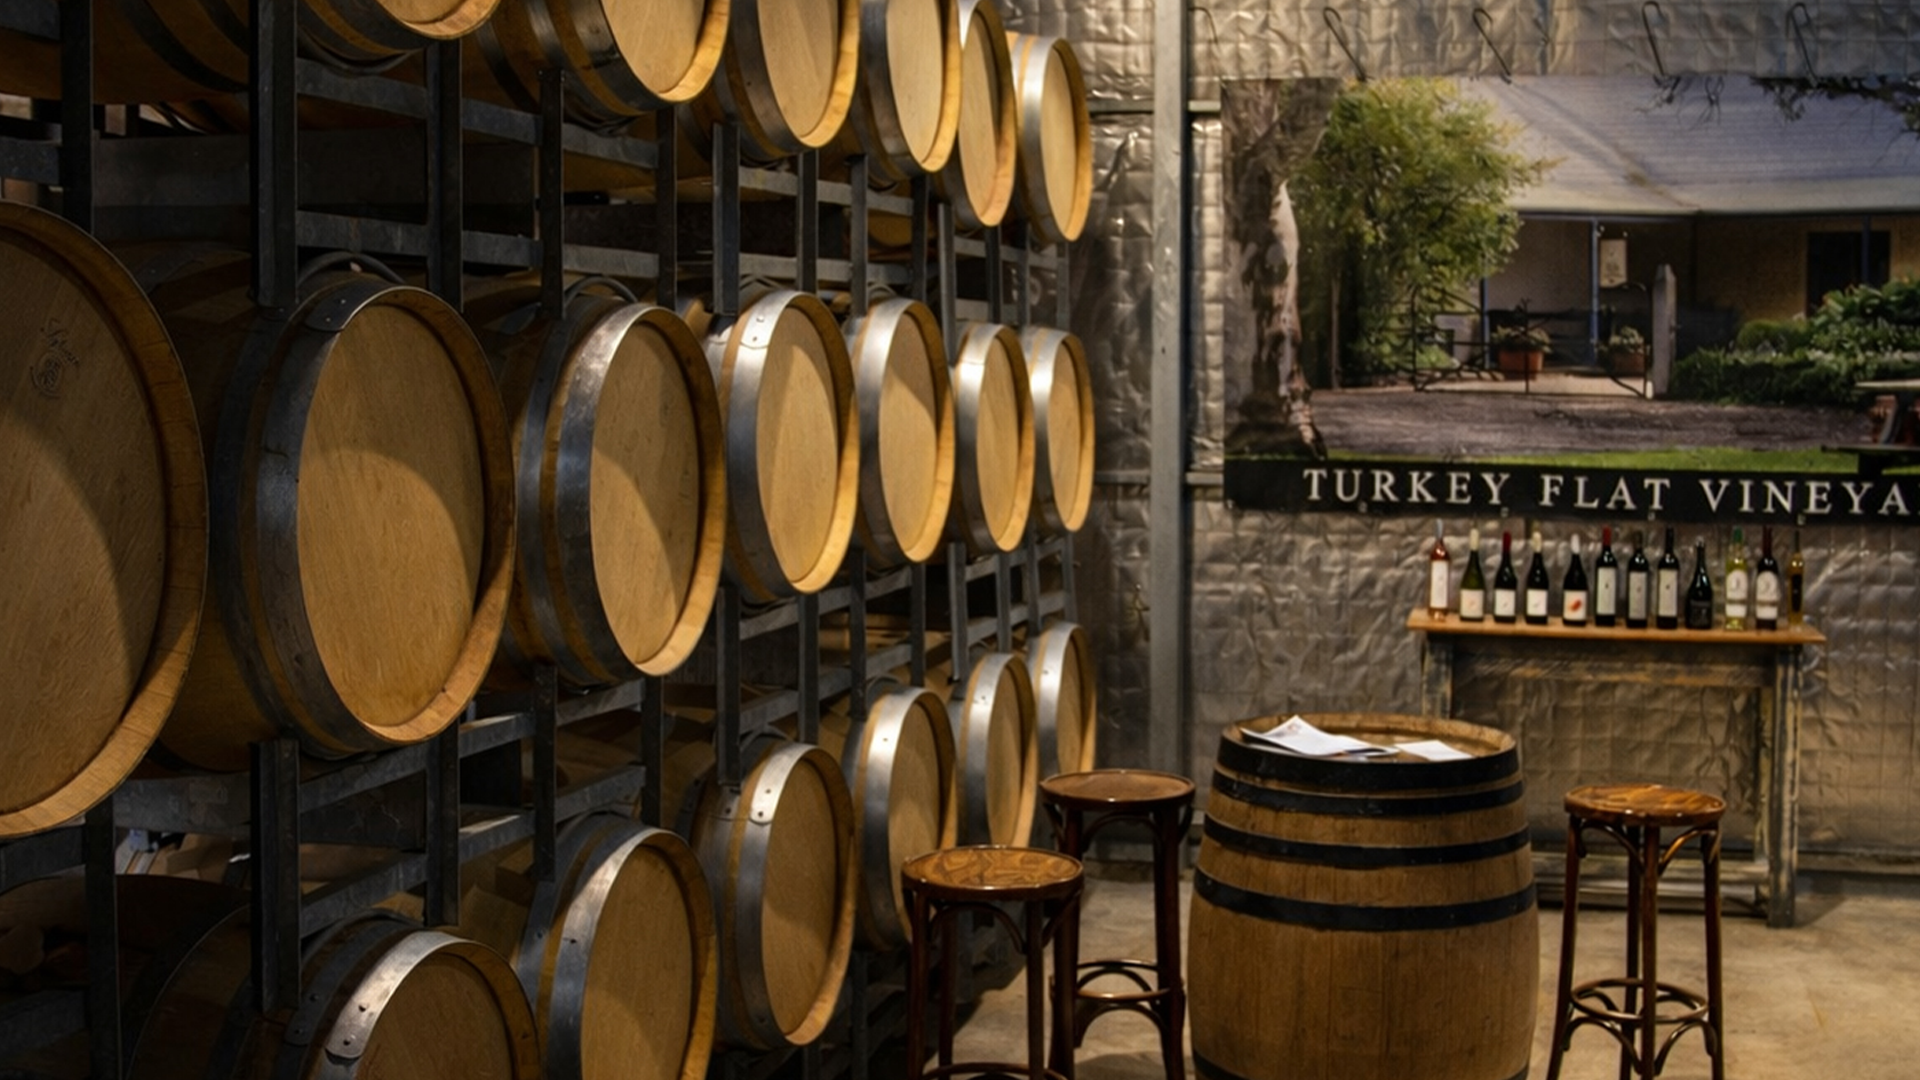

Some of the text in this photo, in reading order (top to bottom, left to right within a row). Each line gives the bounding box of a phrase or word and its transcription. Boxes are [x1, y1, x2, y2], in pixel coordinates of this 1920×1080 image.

[1302, 468, 1920, 515] TURKEY FLAT VINEYA
